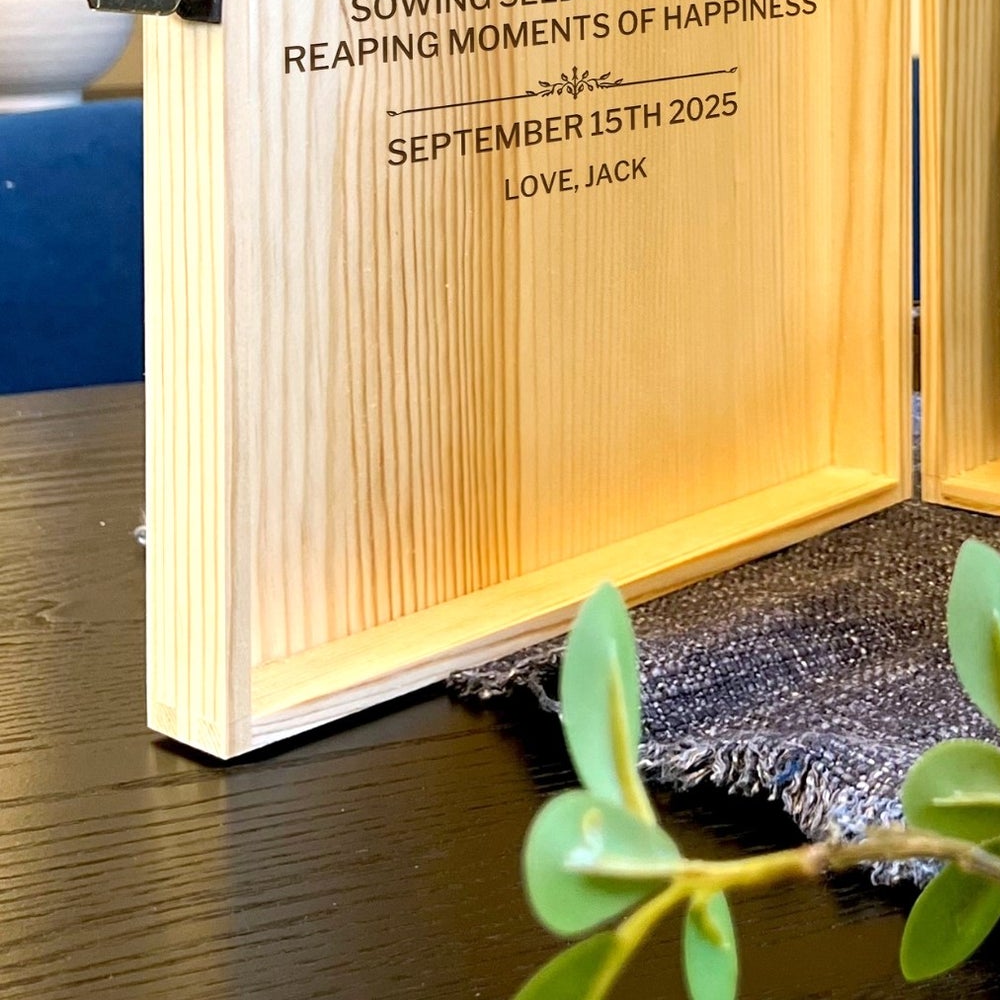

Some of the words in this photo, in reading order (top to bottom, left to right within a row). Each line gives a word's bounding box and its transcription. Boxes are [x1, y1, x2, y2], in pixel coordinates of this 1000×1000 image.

[284, 31, 439, 73] REAPING
[448, 13, 610, 56] MOMENTS
[617, 8, 655, 35] OF
[388, 113, 583, 166] SEPTEMBER
[590, 101, 661, 136] 15TH
[669, 91, 738, 125] 2025
[504, 169, 579, 200] LOVE,
[585, 157, 648, 187] JACK
